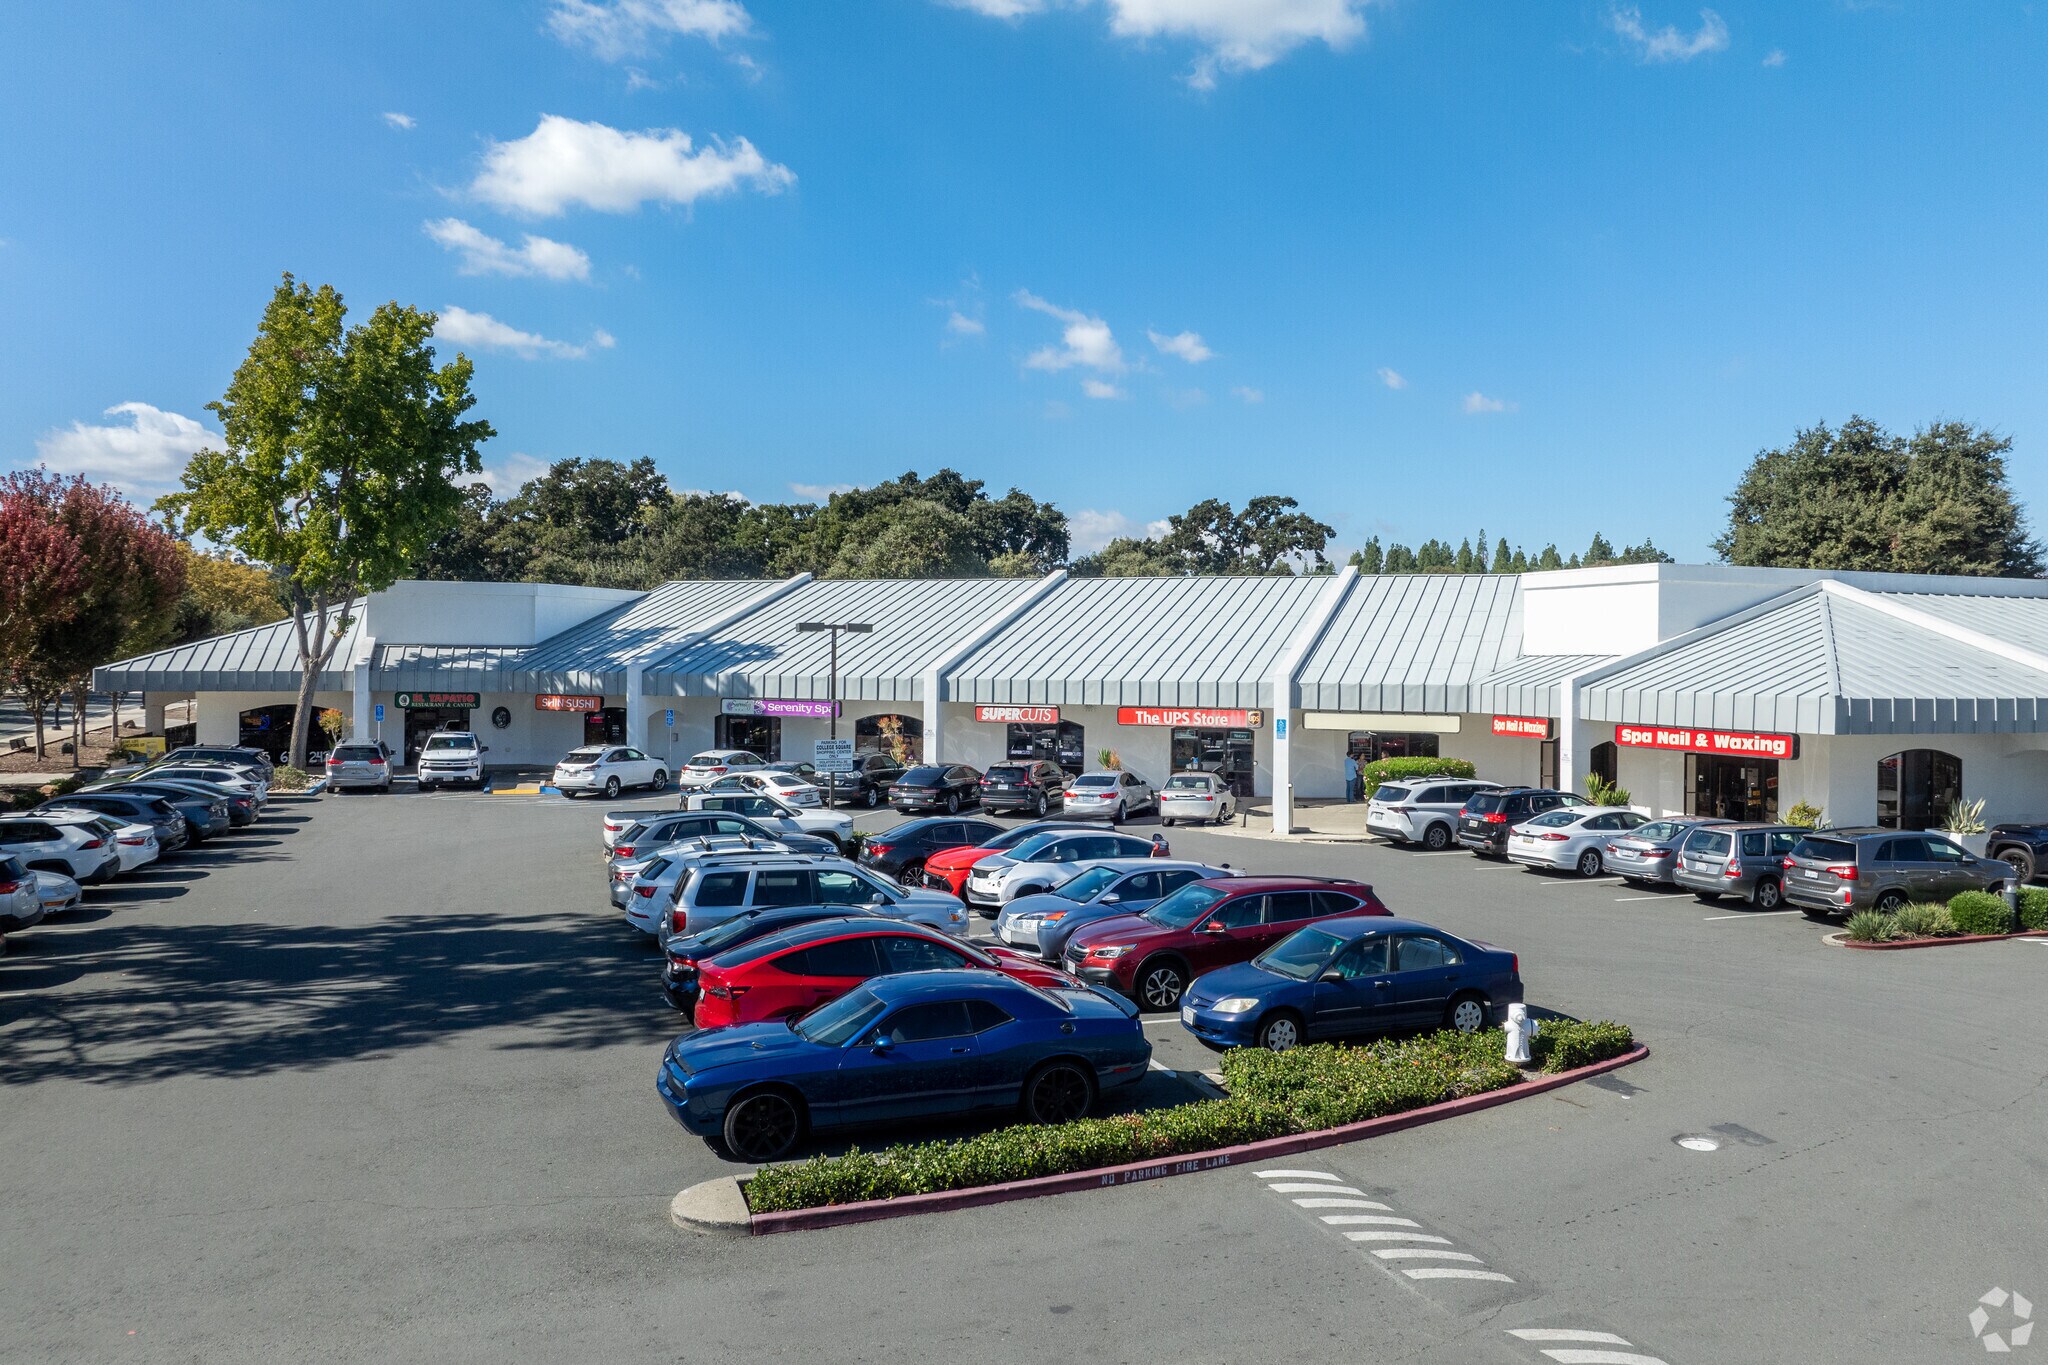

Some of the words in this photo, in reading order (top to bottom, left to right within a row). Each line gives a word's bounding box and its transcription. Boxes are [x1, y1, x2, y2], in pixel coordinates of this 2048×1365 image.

[412, 693, 425, 703] EL
[428, 693, 475, 703] TAPATIO
[541, 697, 565, 707] SHIN
[566, 698, 595, 709] SUSHI
[767, 703, 813, 715] Serenity
[981, 706, 1052, 722] SUPERCUTS
[1135, 710, 1160, 724] The
[1163, 711, 1190, 725] UPS
[1193, 712, 1229, 726] Store
[1493, 719, 1506, 732] Spa
[1506, 720, 1518, 732] Nail
[1518, 721, 1524, 733] &
[1523, 722, 1546, 736] Waxing
[1621, 728, 1653, 745] Spa
[1657, 731, 1691, 746] Nail
[1695, 733, 1709, 748] &
[1713, 734, 1786, 755] Waxing
[1101, 1173, 1115, 1185] NO
[1124, 1165, 1168, 1182] PARKING
[1175, 1160, 1199, 1173] FIRE
[1205, 1154, 1231, 1168] LANE
